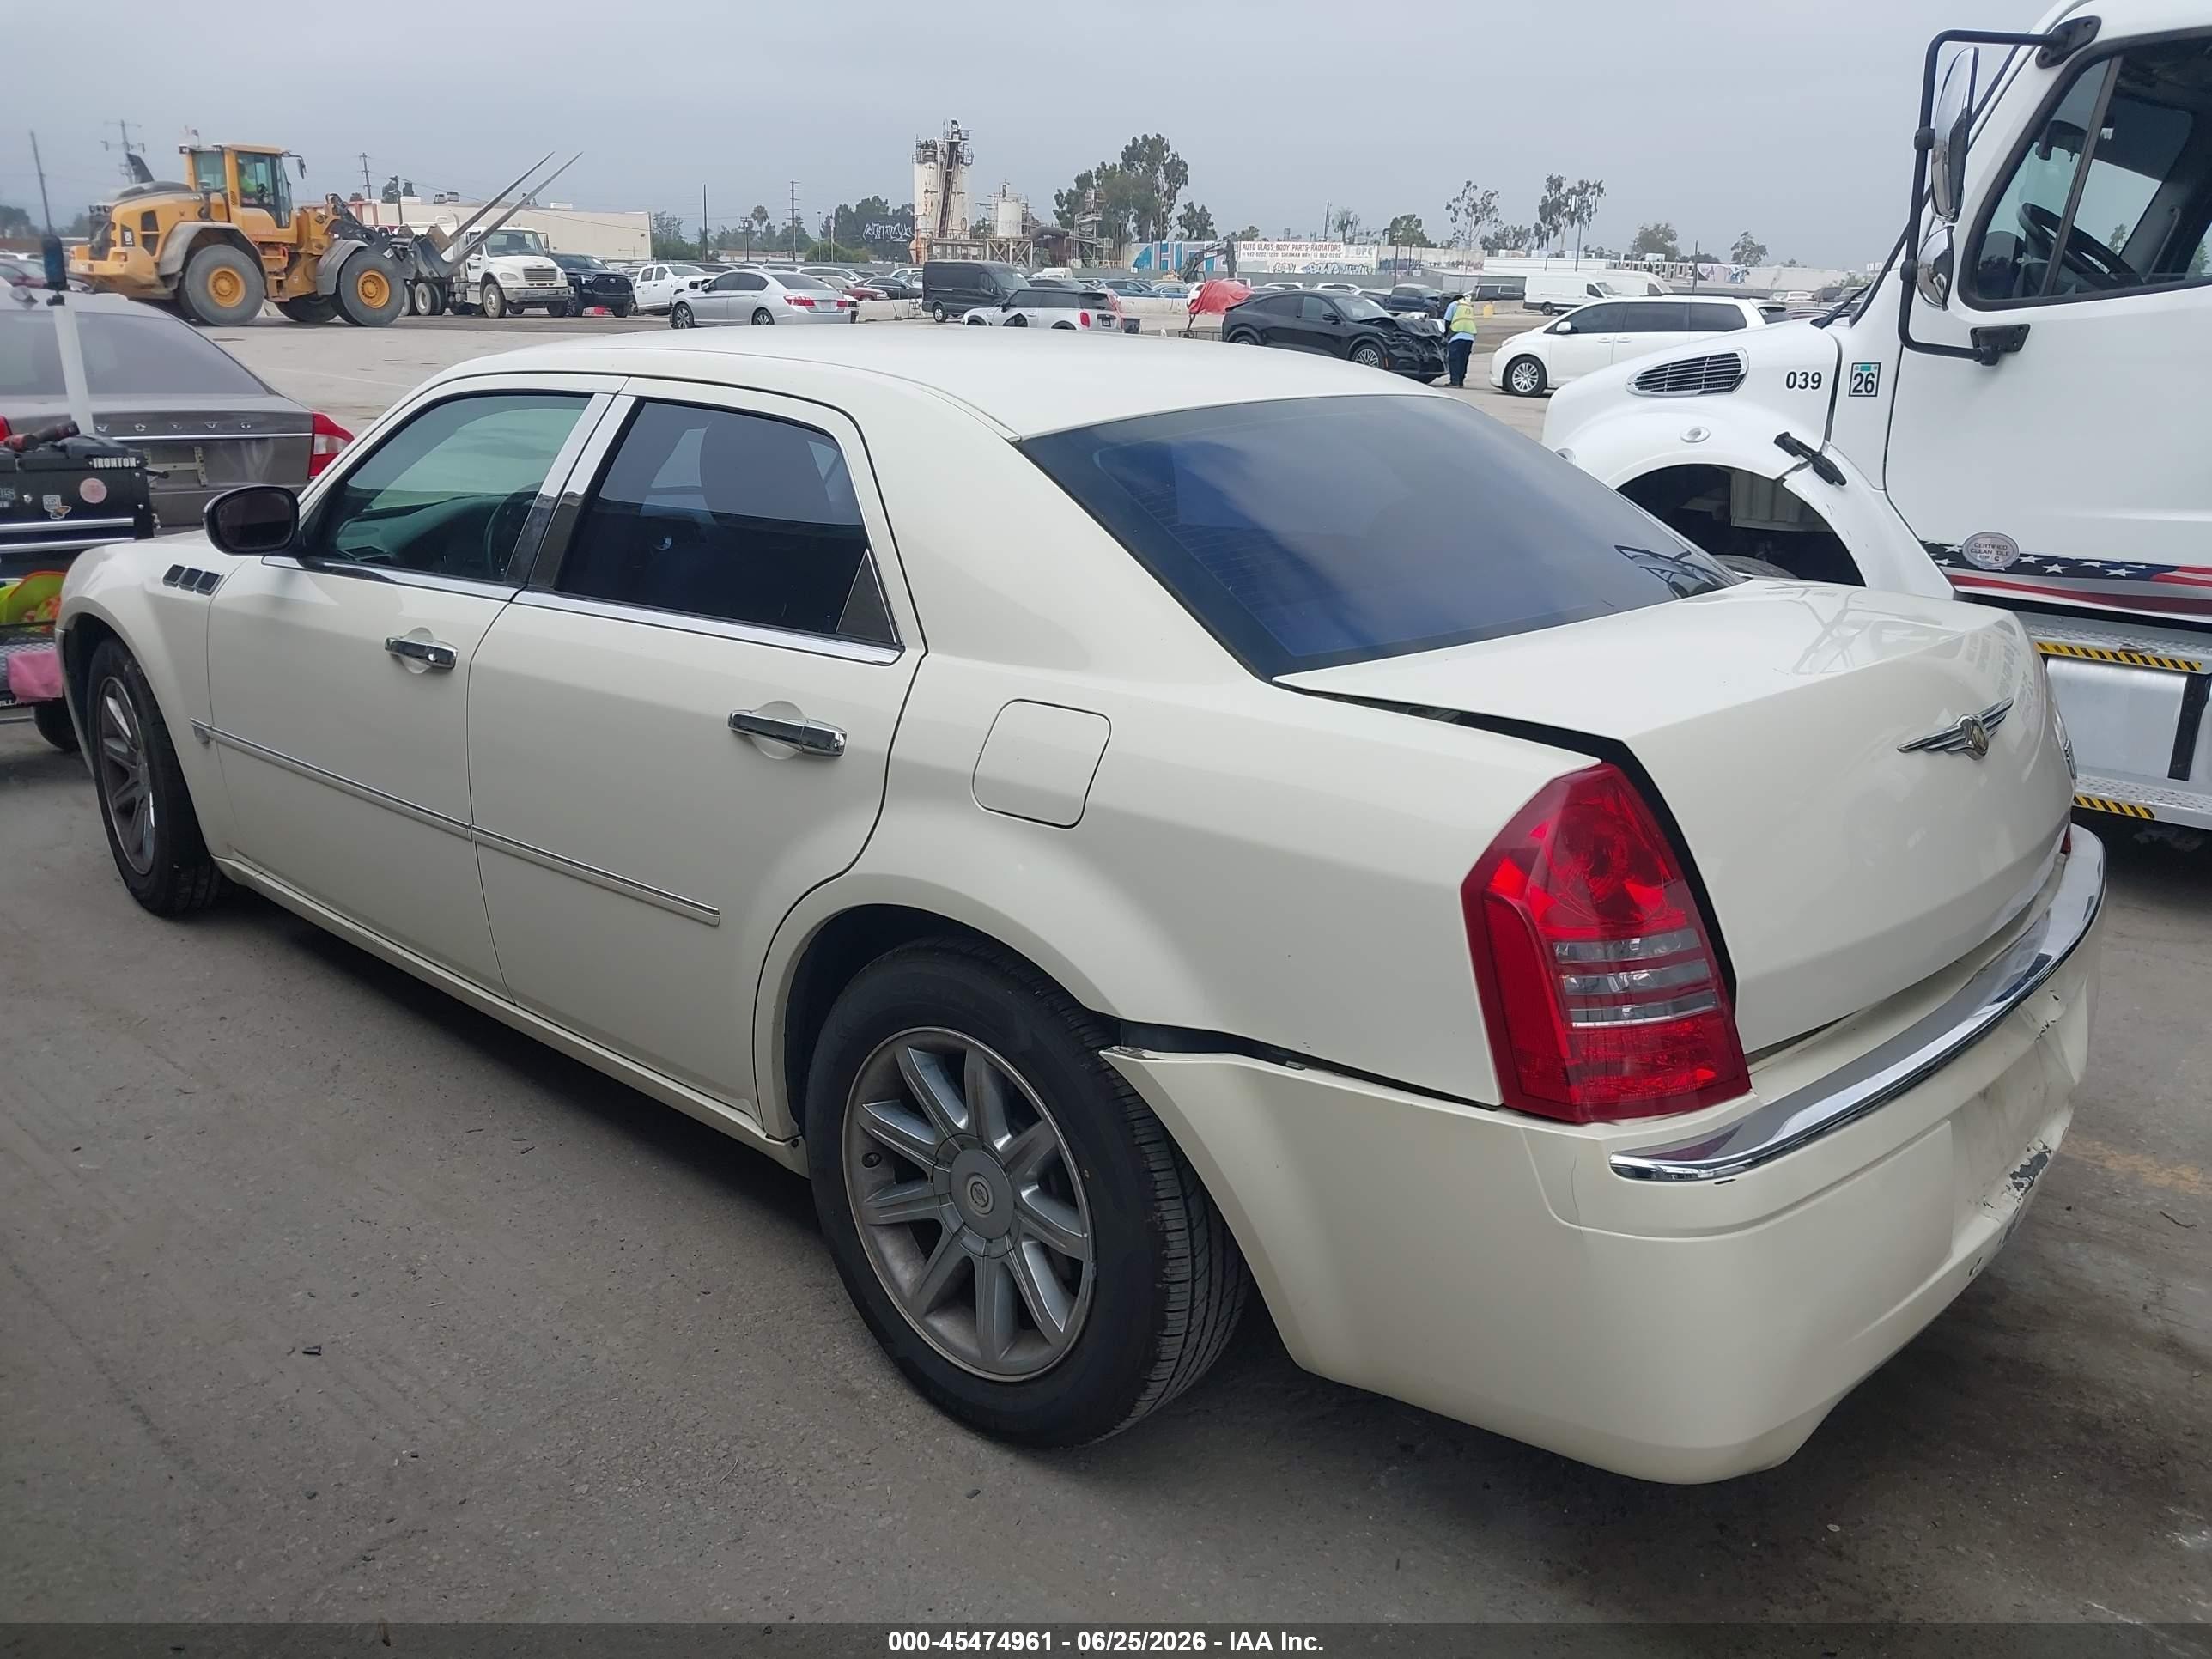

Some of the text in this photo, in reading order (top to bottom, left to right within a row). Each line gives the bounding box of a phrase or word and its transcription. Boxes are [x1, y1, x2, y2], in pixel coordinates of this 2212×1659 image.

[1785, 371, 1822, 390] 039
[1851, 372, 1875, 394] 26
[93, 457, 137, 469] IRONTON
[1973, 542, 2008, 550] CERTIFIED
